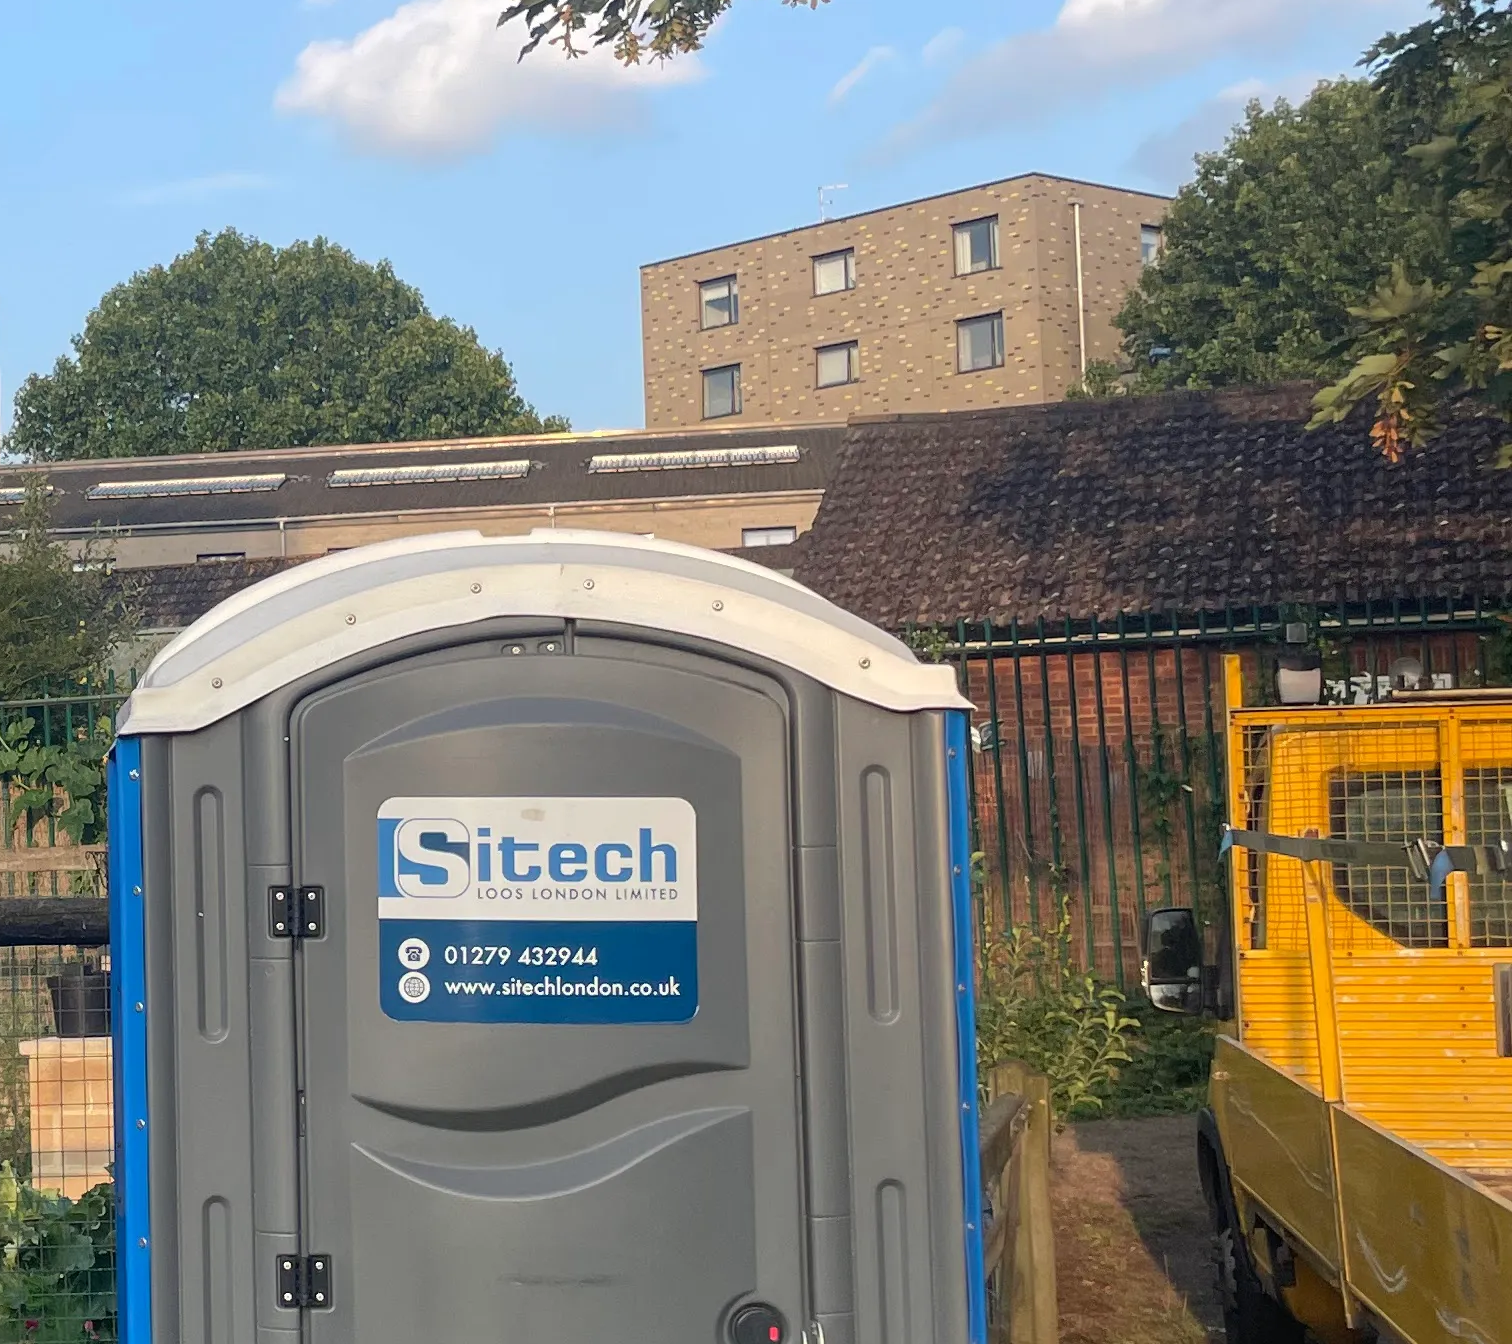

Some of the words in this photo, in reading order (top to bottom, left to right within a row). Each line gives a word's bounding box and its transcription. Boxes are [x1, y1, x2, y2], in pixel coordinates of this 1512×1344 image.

[397, 818, 678, 898] Sitech
[477, 887, 523, 900] LOOS
[532, 887, 607, 900] LONDON
[615, 888, 678, 901] LIMITED
[444, 946, 511, 965] 01279
[517, 946, 598, 965] 432944
[444, 976, 681, 997] www.sitechlondon.co.uk
